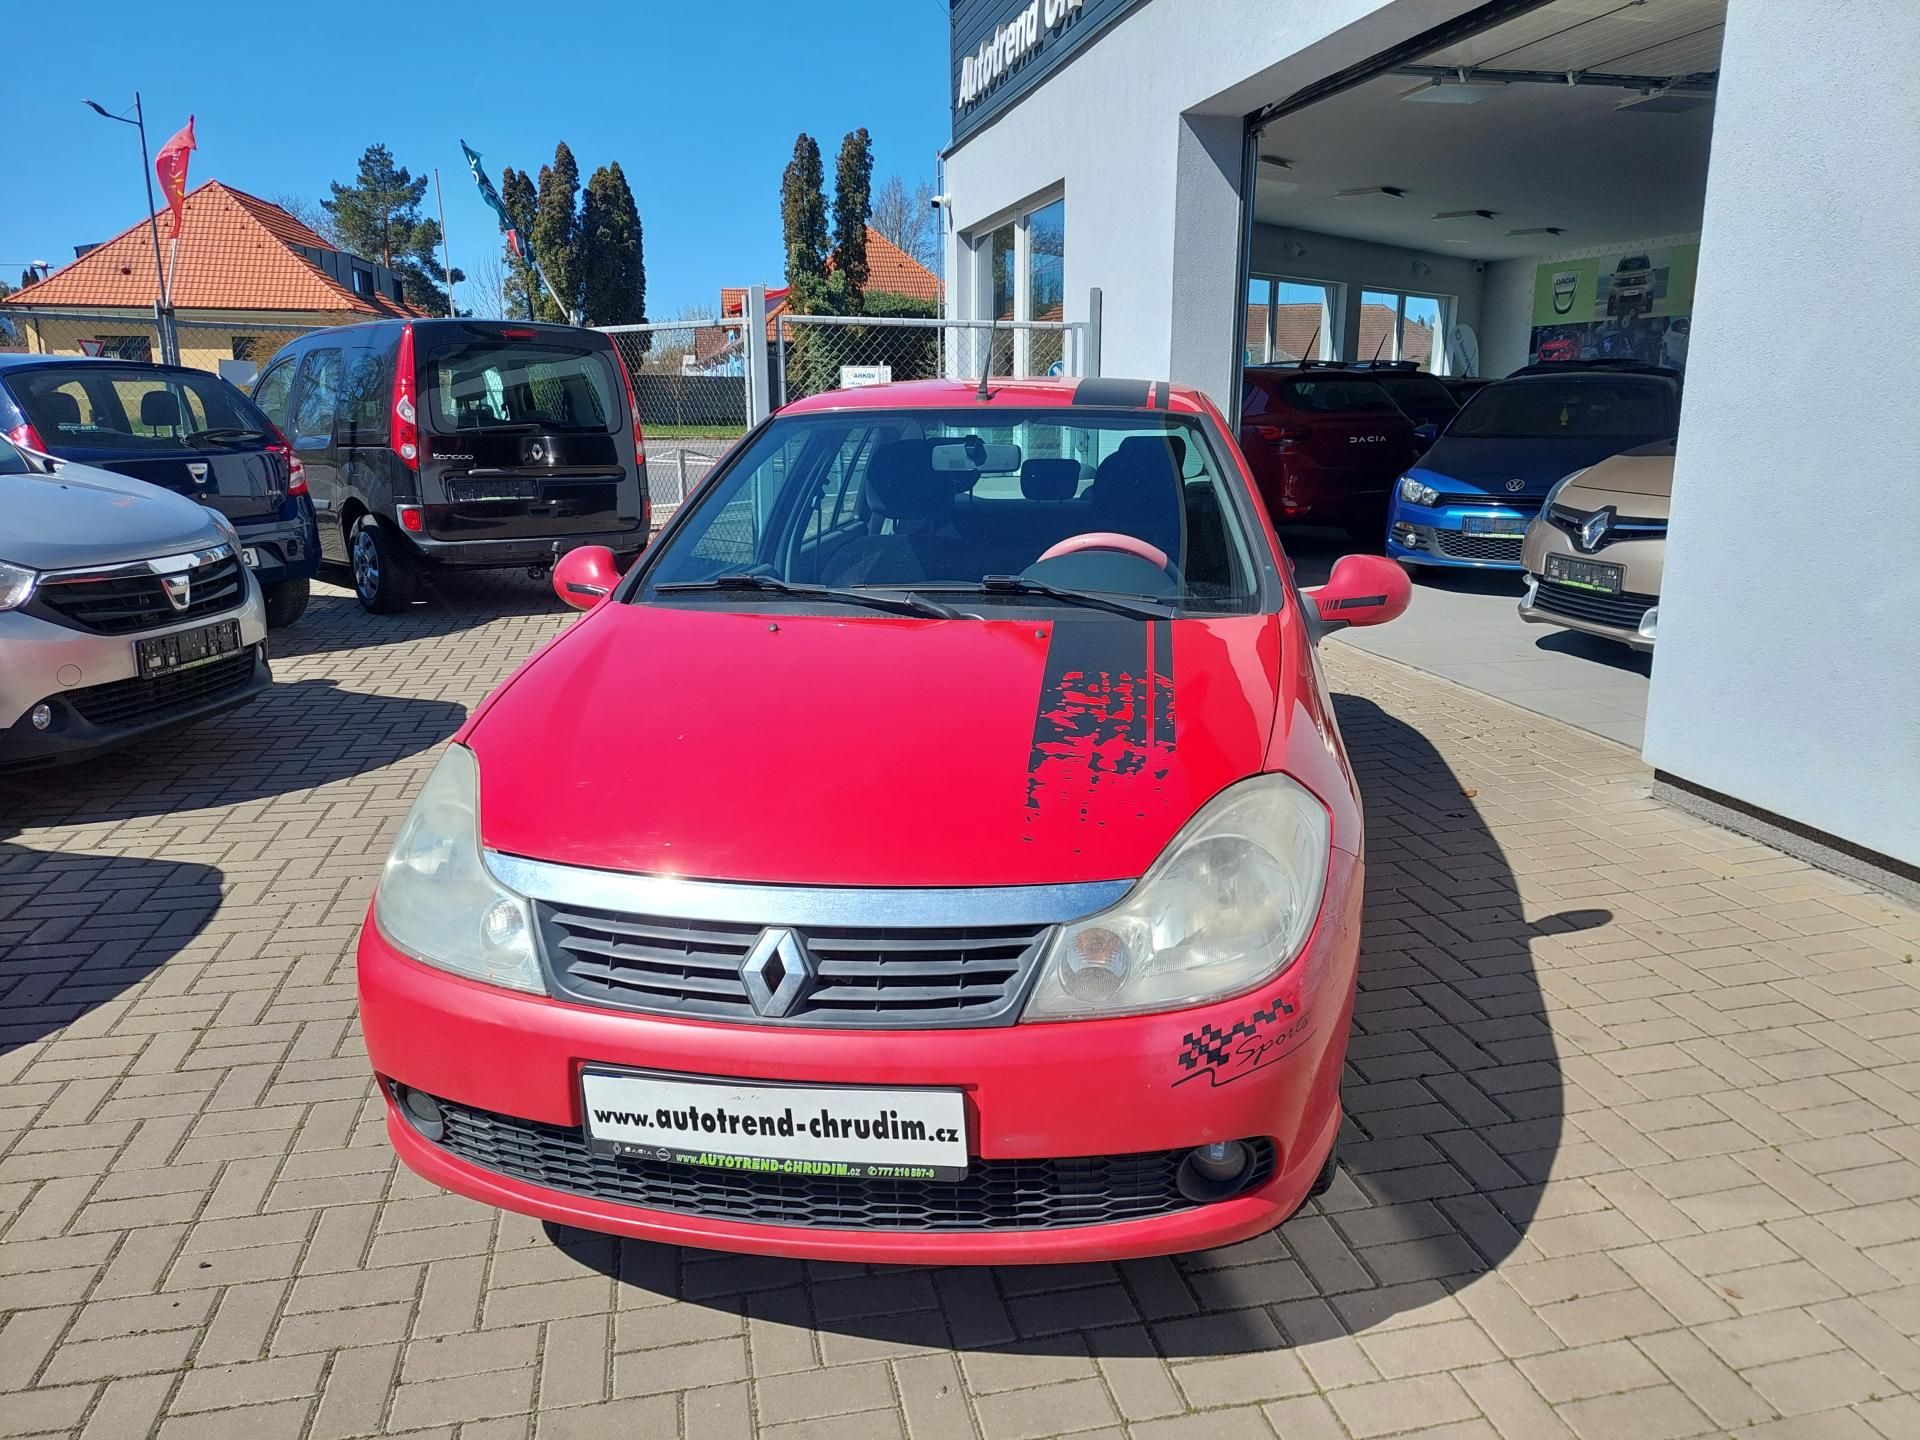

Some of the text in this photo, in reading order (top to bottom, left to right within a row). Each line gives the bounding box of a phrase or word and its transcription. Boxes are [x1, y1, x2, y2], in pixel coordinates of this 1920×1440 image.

[958, 0, 1040, 108] Autotrend
[1555, 276, 1576, 286] DACIA
[1349, 435, 1387, 443] DACIA
[593, 1106, 959, 1143] www.autotrend-chrudim.cz
[675, 1153, 861, 1177] www.AUTOTREND-CHRUDIM.cz
[878, 1167, 894, 1177] 777
